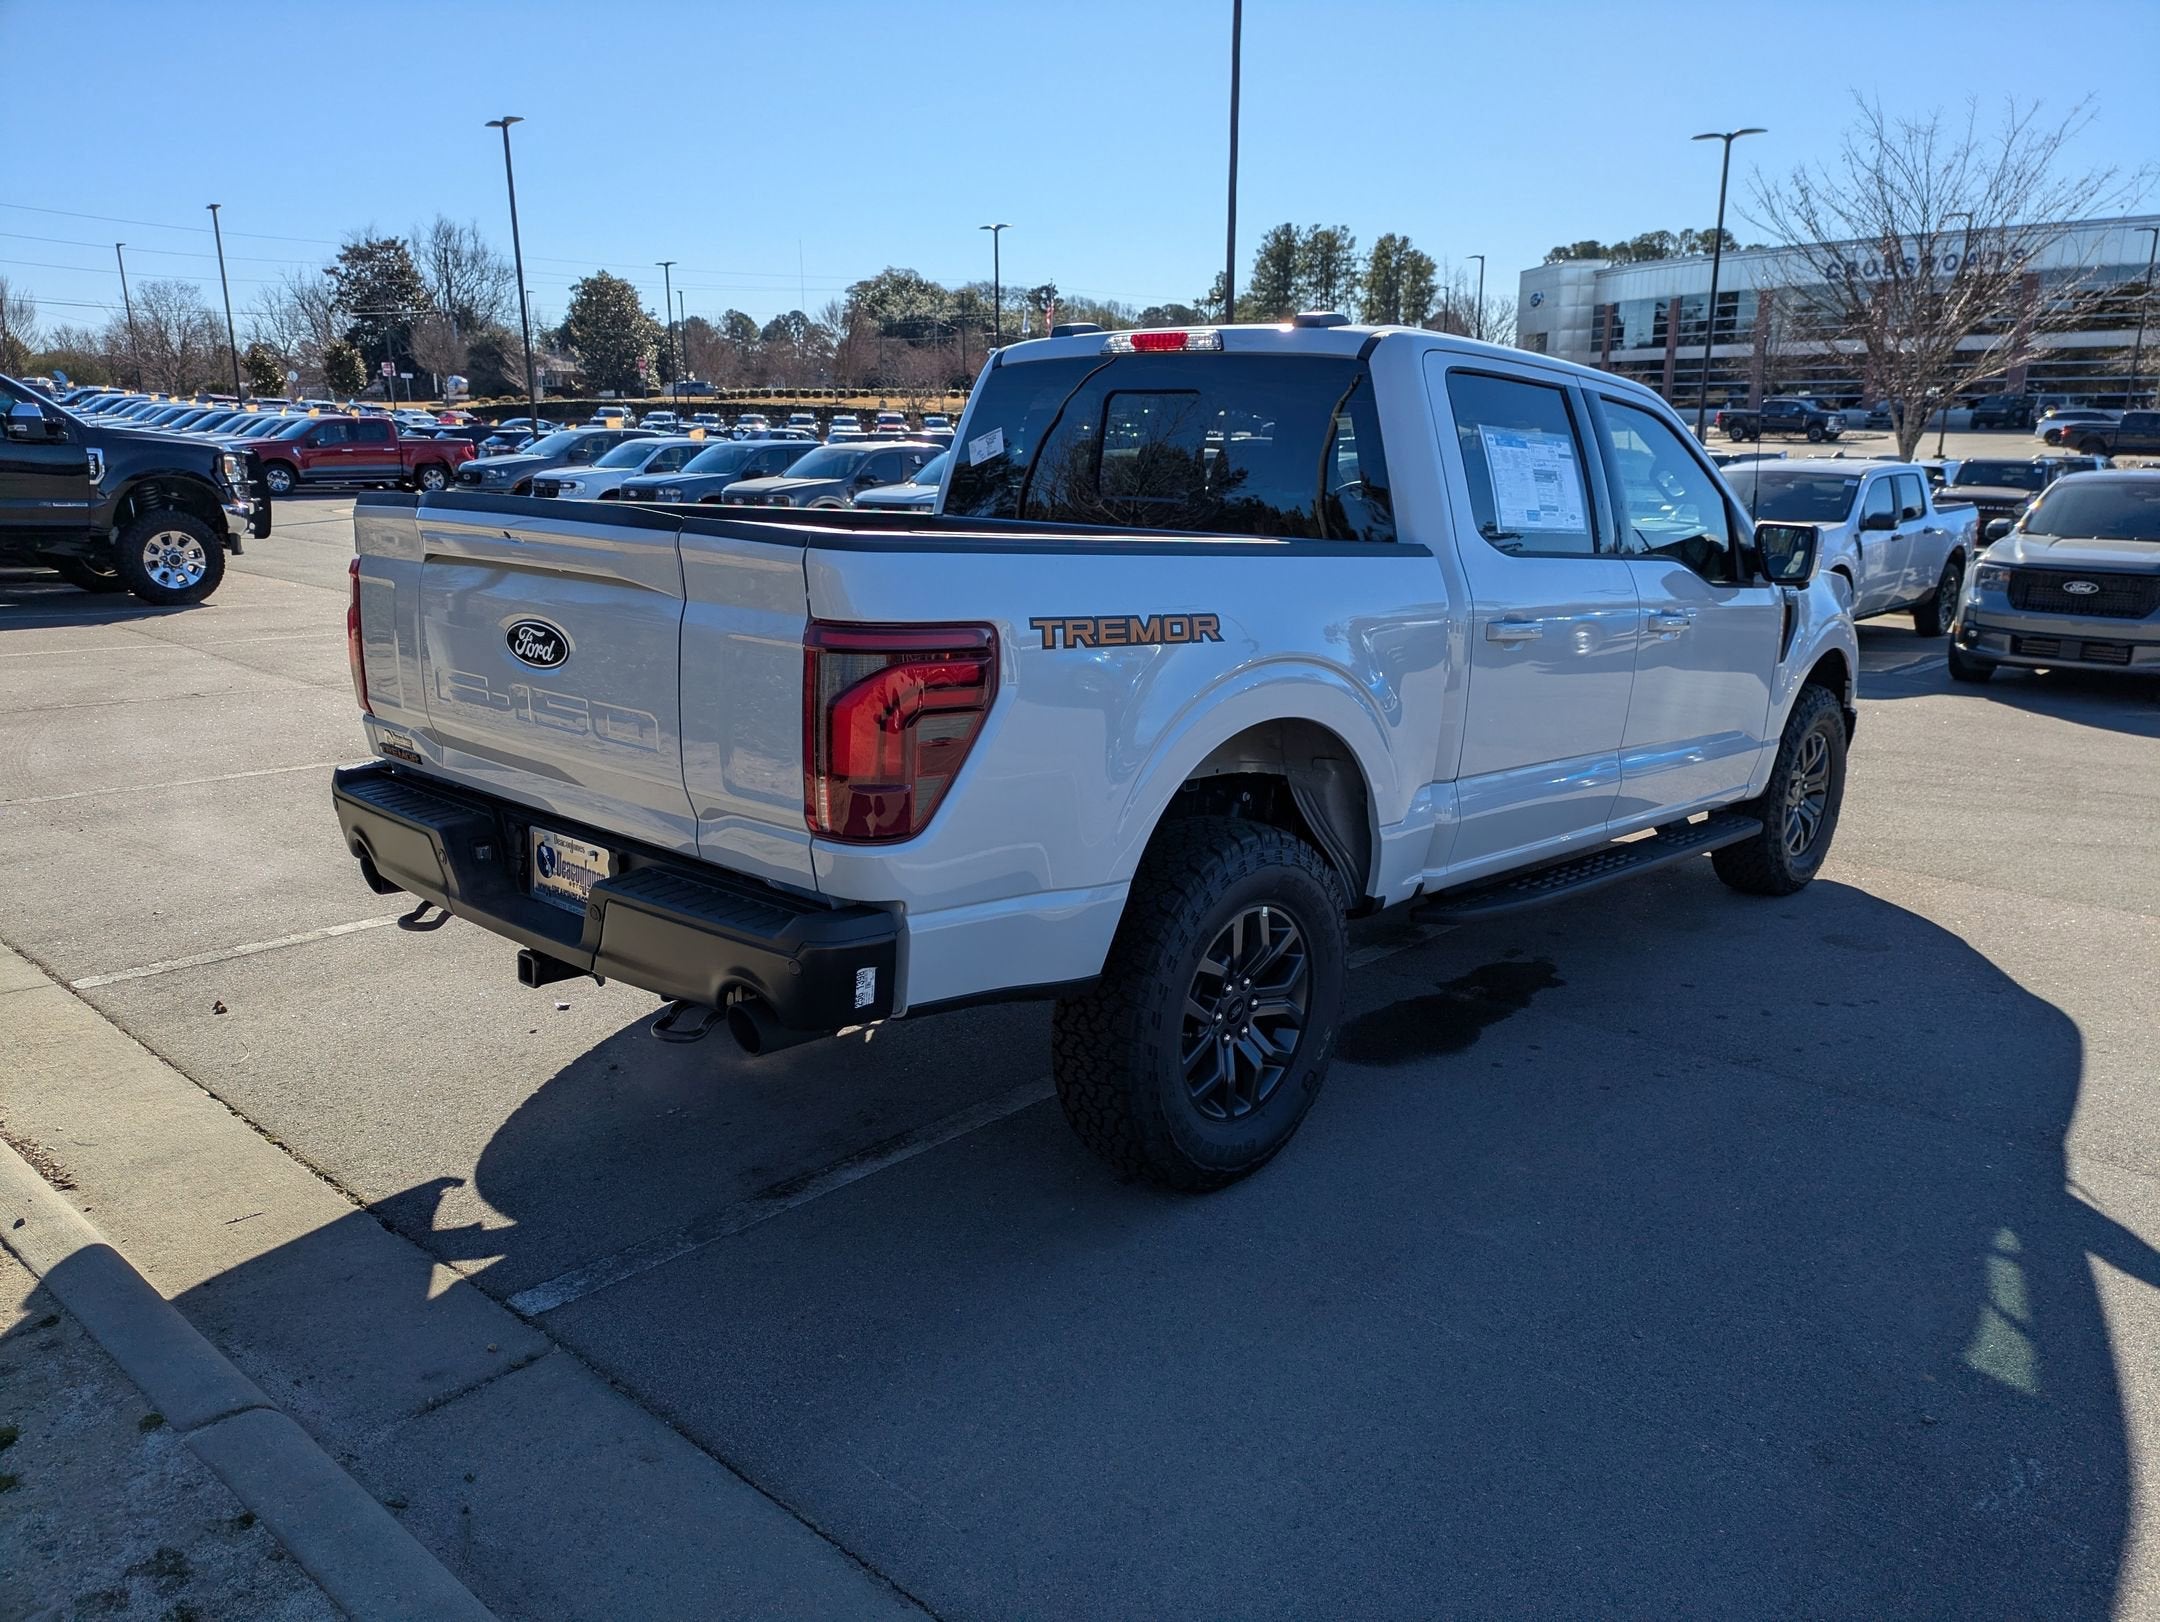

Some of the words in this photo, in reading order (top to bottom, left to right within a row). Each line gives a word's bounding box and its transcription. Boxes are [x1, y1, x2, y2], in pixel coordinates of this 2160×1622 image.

[1826, 250, 2027, 279] CROSOAS
[514, 626, 555, 661] Ford
[1029, 613, 1226, 650] TREMOR
[435, 667, 660, 752] F-150
[556, 850, 606, 895] DeaconJon
